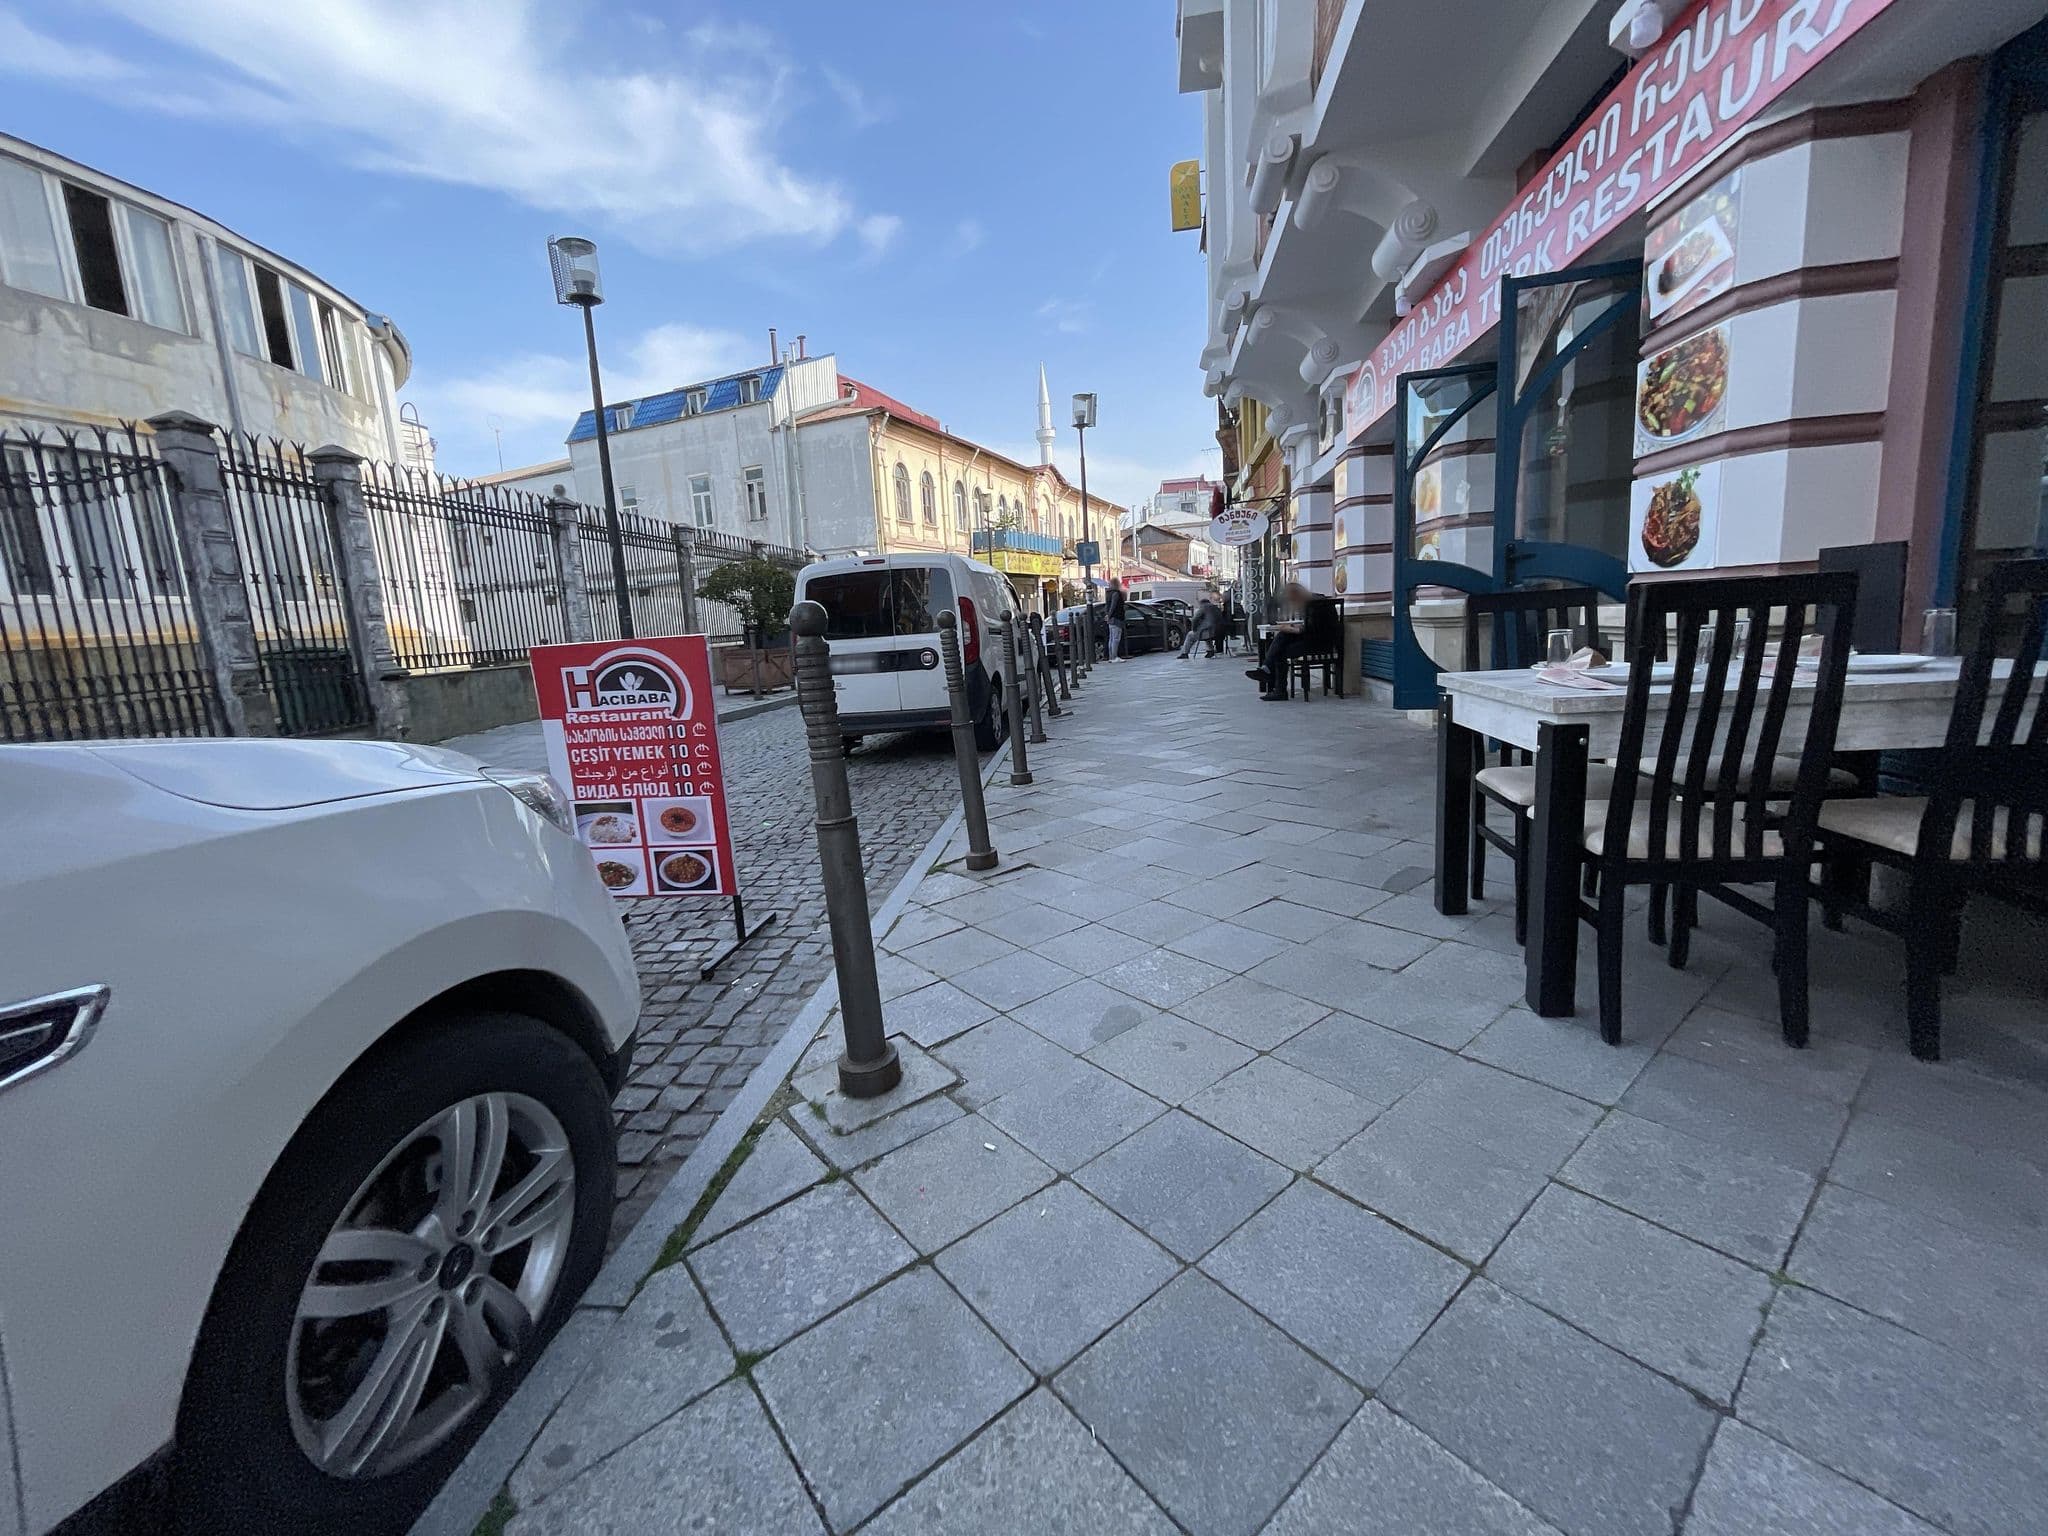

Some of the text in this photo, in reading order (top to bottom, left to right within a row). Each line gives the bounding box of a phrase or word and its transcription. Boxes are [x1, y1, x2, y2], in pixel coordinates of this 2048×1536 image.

[1480, 103, 1621, 280] თურქული
[1420, 309, 1470, 371] BABA
[565, 710, 672, 725] Restaurant
[667, 724, 686, 739] 10
[571, 746, 610, 766] ÇEŞİT
[612, 744, 666, 761] YEMEK
[669, 743, 689, 759] 10
[621, 767, 638, 780] من
[640, 761, 669, 781] أنواع
[672, 762, 692, 778] 10
[576, 784, 619, 800] ВИДА
[621, 781, 671, 798] БЛЮД
[674, 781, 694, 796] 10
